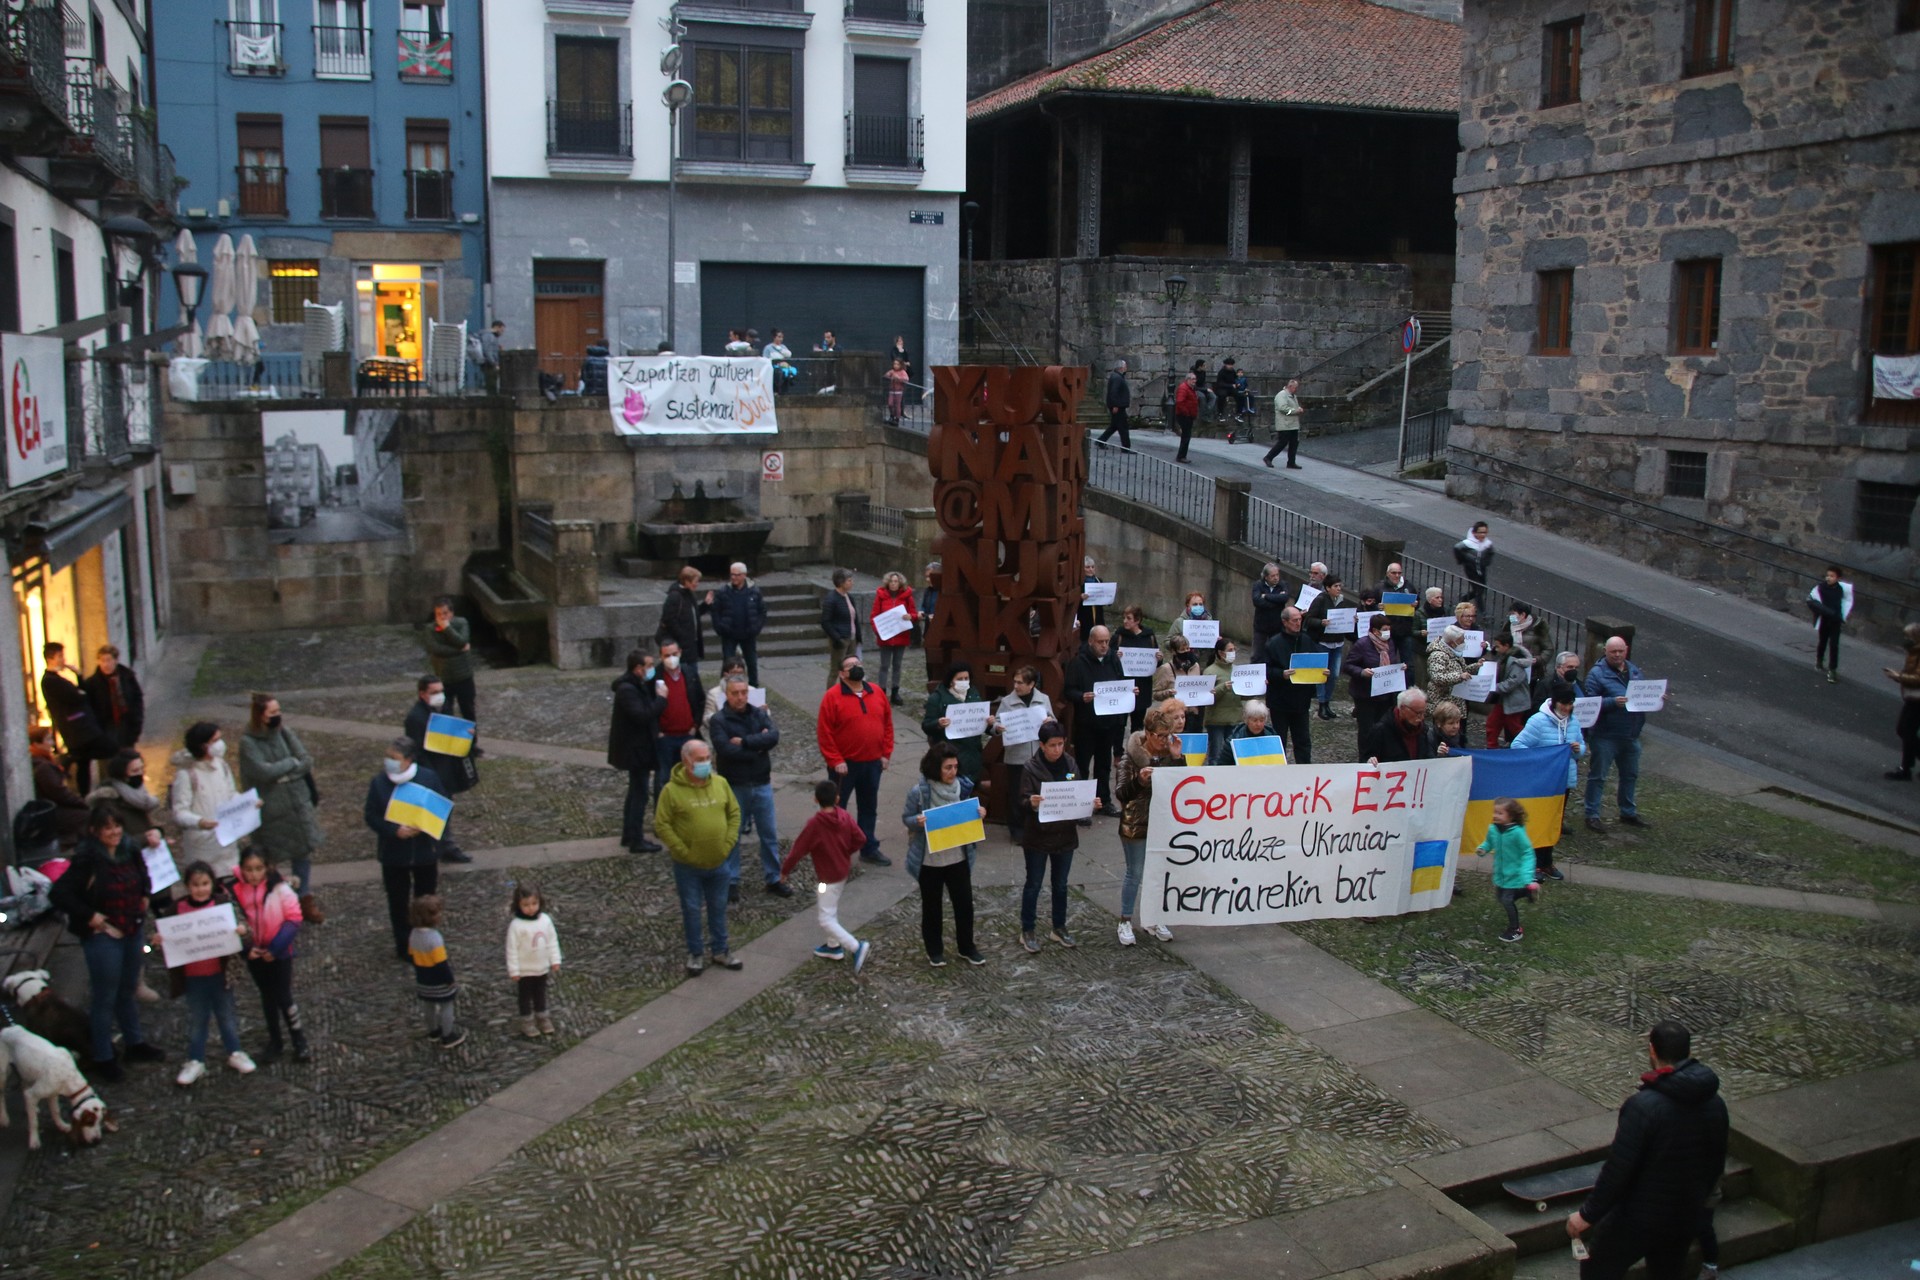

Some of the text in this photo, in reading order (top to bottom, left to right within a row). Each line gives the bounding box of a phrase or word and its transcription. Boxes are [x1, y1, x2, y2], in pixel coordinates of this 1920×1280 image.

[617, 358, 754, 395] Zapaltzen gaituen
[1178, 680, 1208, 688] GERRARIK
[1233, 669, 1260, 677] GERRARIK
[1374, 668, 1398, 679] GERRARIK
[1096, 686, 1128, 695] GERRARIK
[1352, 767, 1428, 815] EZ!!
[1166, 826, 1287, 866] Soraluze
[1334, 863, 1386, 904] bat
